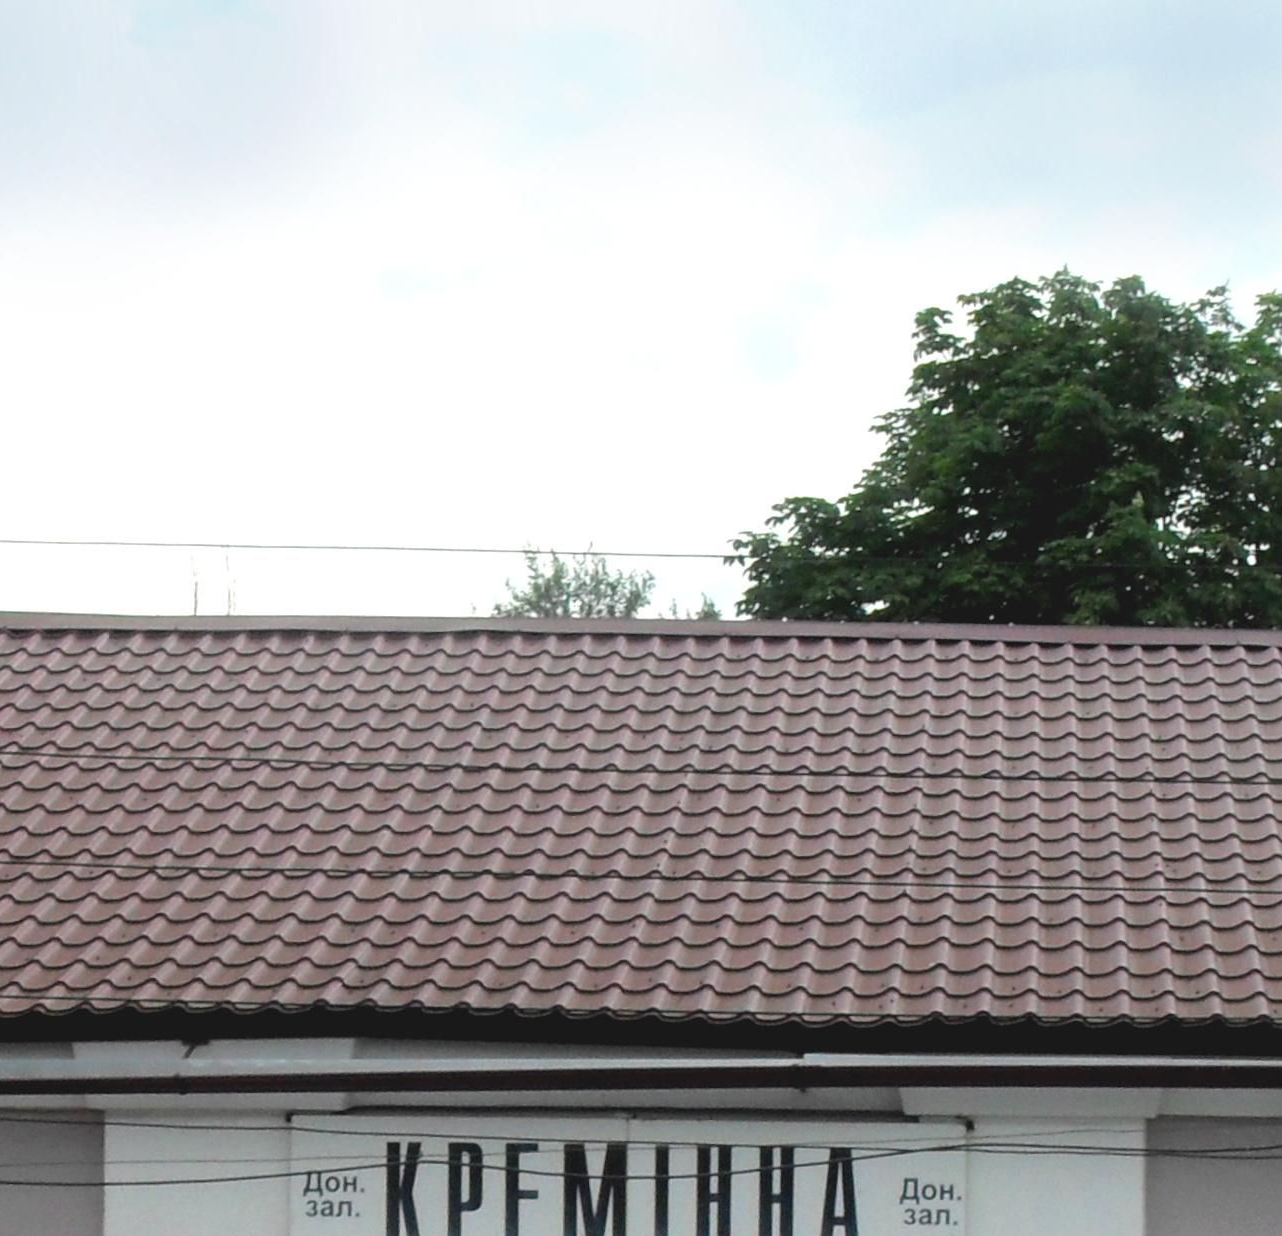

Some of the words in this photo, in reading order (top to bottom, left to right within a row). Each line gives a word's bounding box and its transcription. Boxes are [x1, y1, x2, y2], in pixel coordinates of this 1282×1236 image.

[303, 1171, 365, 1197] Дон.
[899, 1177, 962, 1205] Дон.
[305, 1200, 360, 1217] зал.
[903, 1208, 958, 1226] зал.
